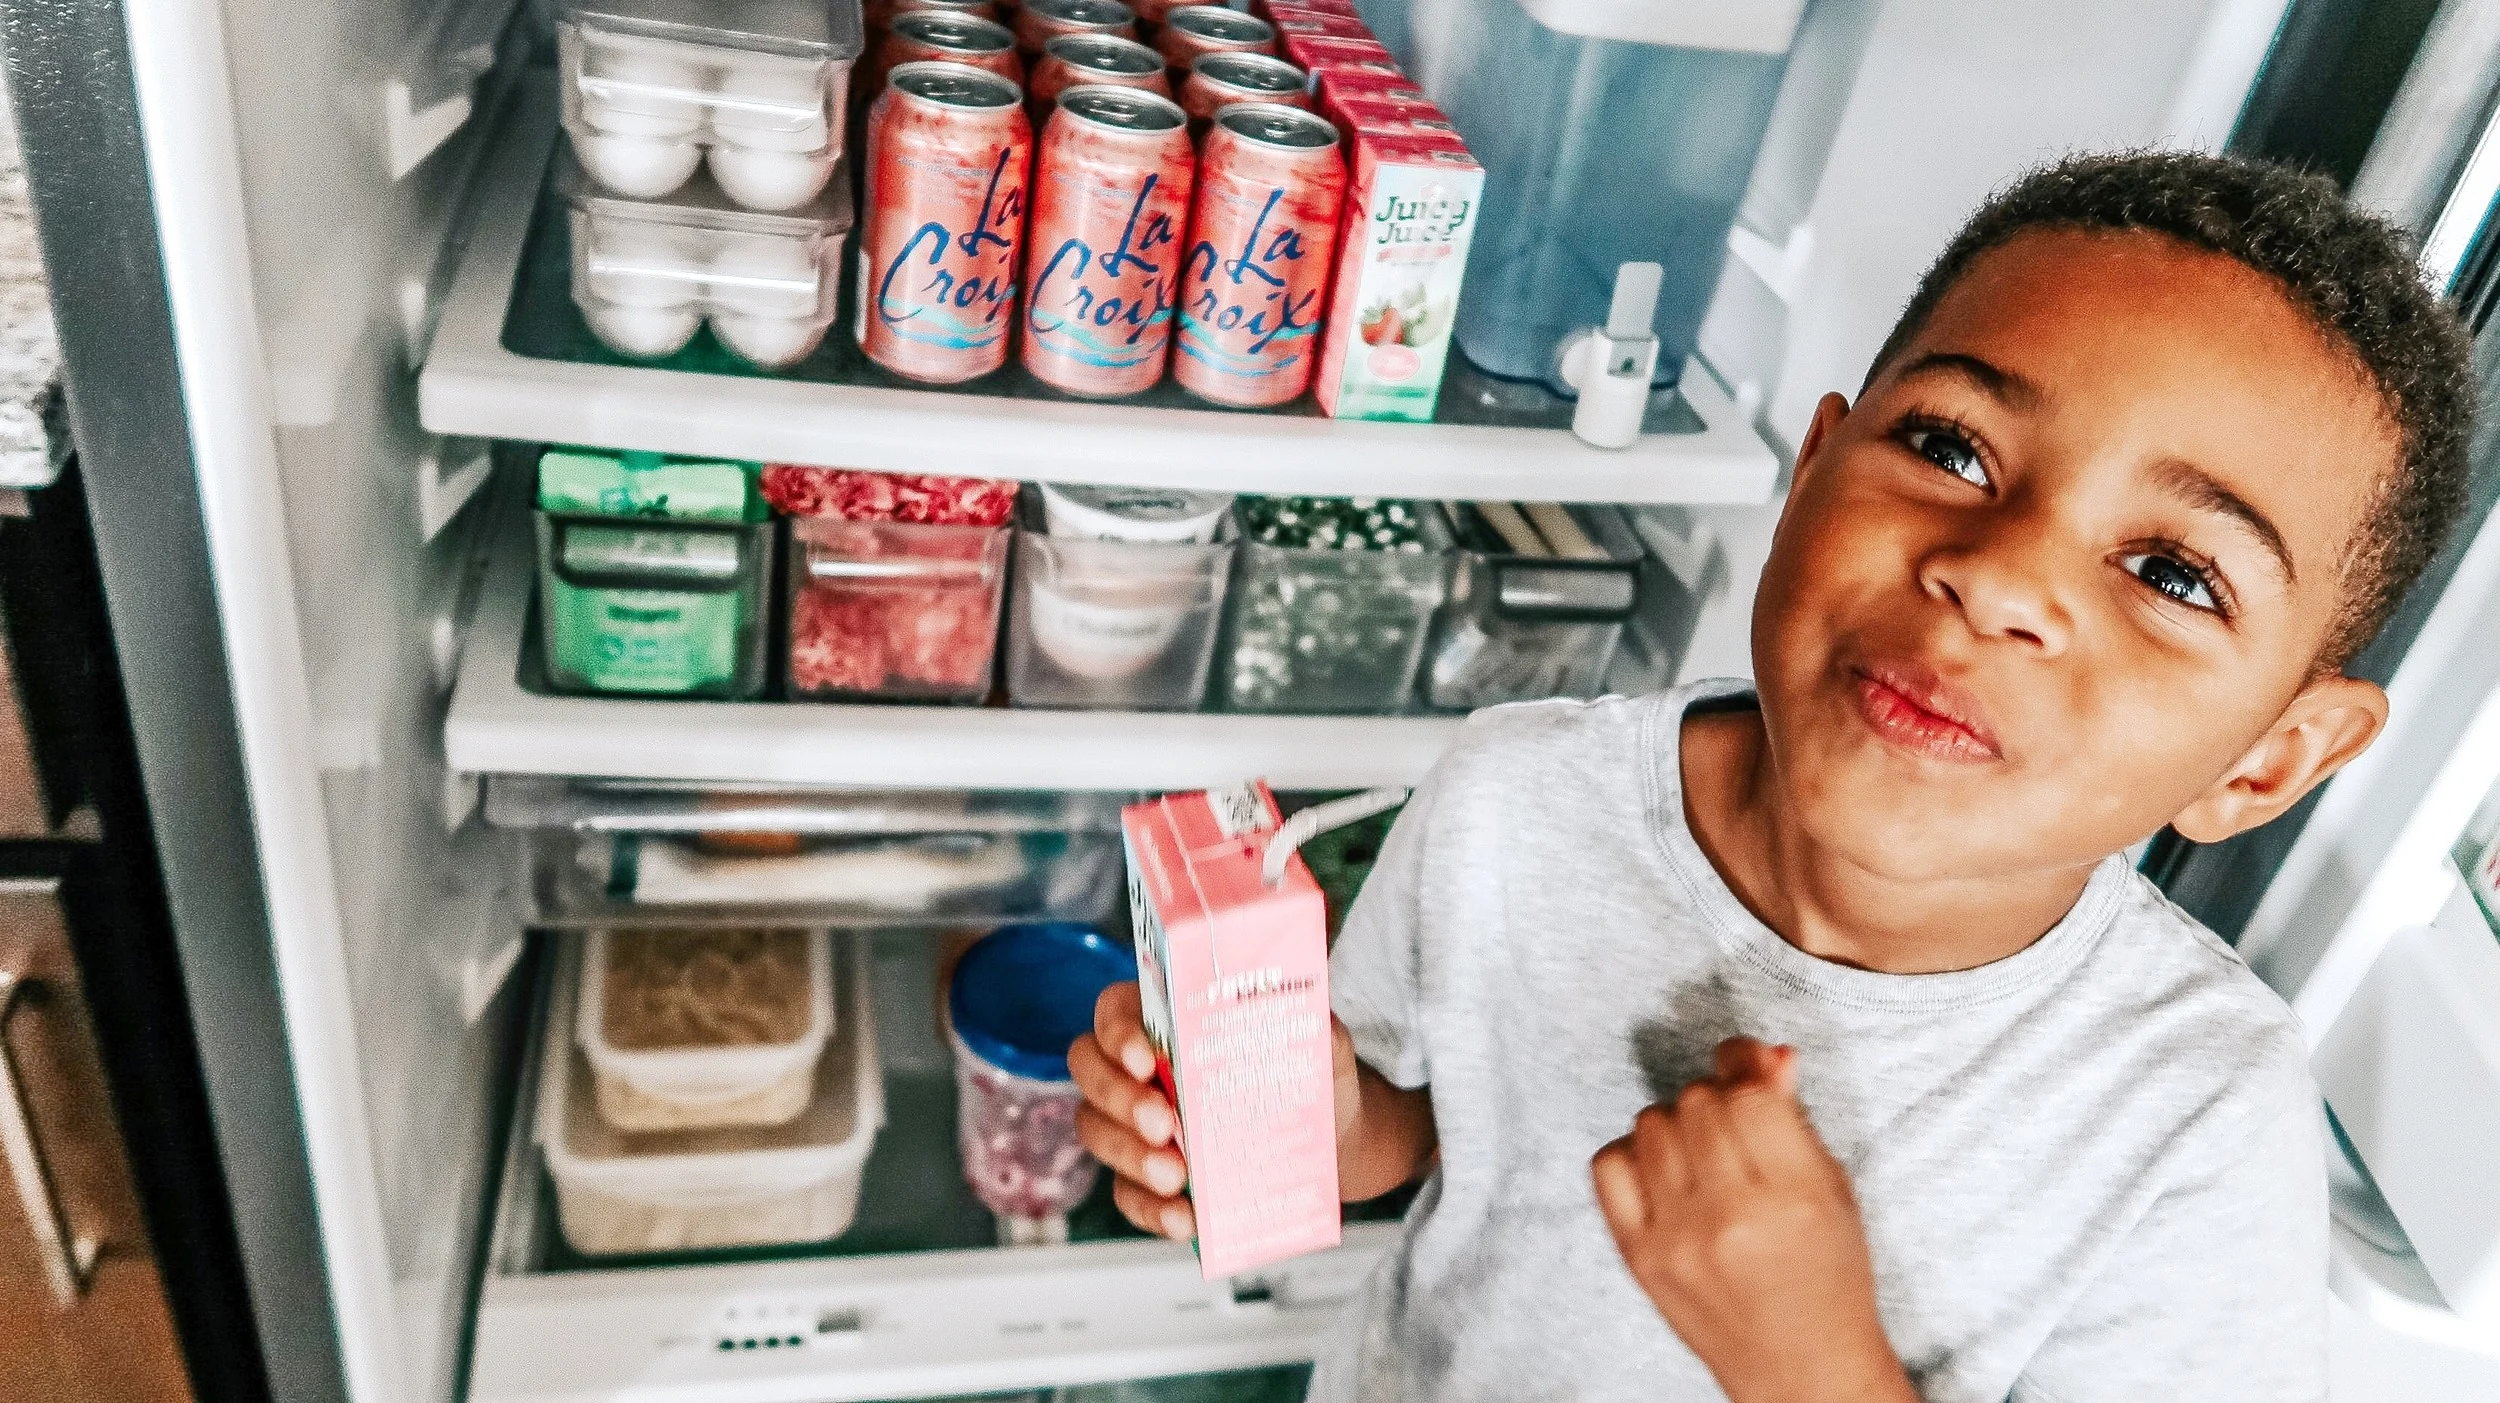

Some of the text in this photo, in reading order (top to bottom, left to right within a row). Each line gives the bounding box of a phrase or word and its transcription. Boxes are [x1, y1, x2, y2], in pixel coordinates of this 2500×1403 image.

[958, 147, 1022, 257] La
[1099, 173, 1174, 277] La
[1225, 187, 1305, 286] La
[1376, 196, 1470, 233] Juicy
[1377, 222, 1453, 245] Juce
